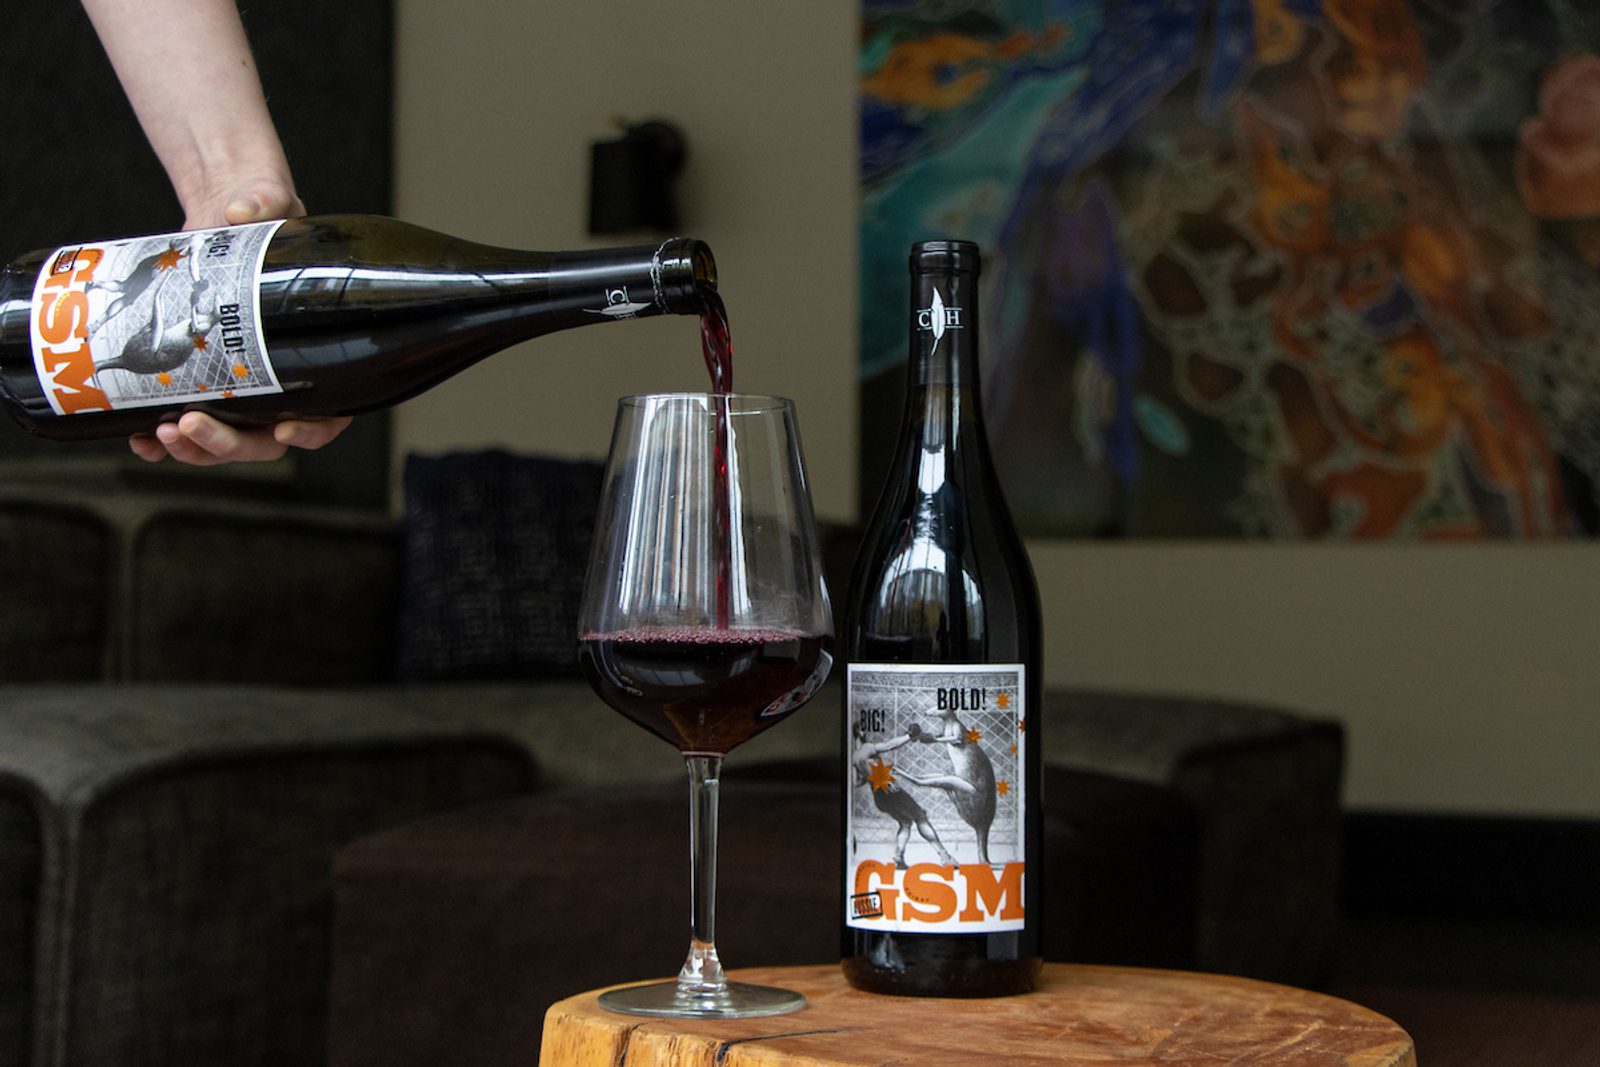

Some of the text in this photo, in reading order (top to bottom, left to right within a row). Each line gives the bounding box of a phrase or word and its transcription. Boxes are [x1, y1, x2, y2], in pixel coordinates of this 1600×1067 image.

[39, 248, 114, 415] GSM
[220, 303, 246, 354] BOLD!
[859, 708, 886, 733] BIG!
[937, 687, 987, 711] BOLD!
[854, 859, 1025, 923] GSM
